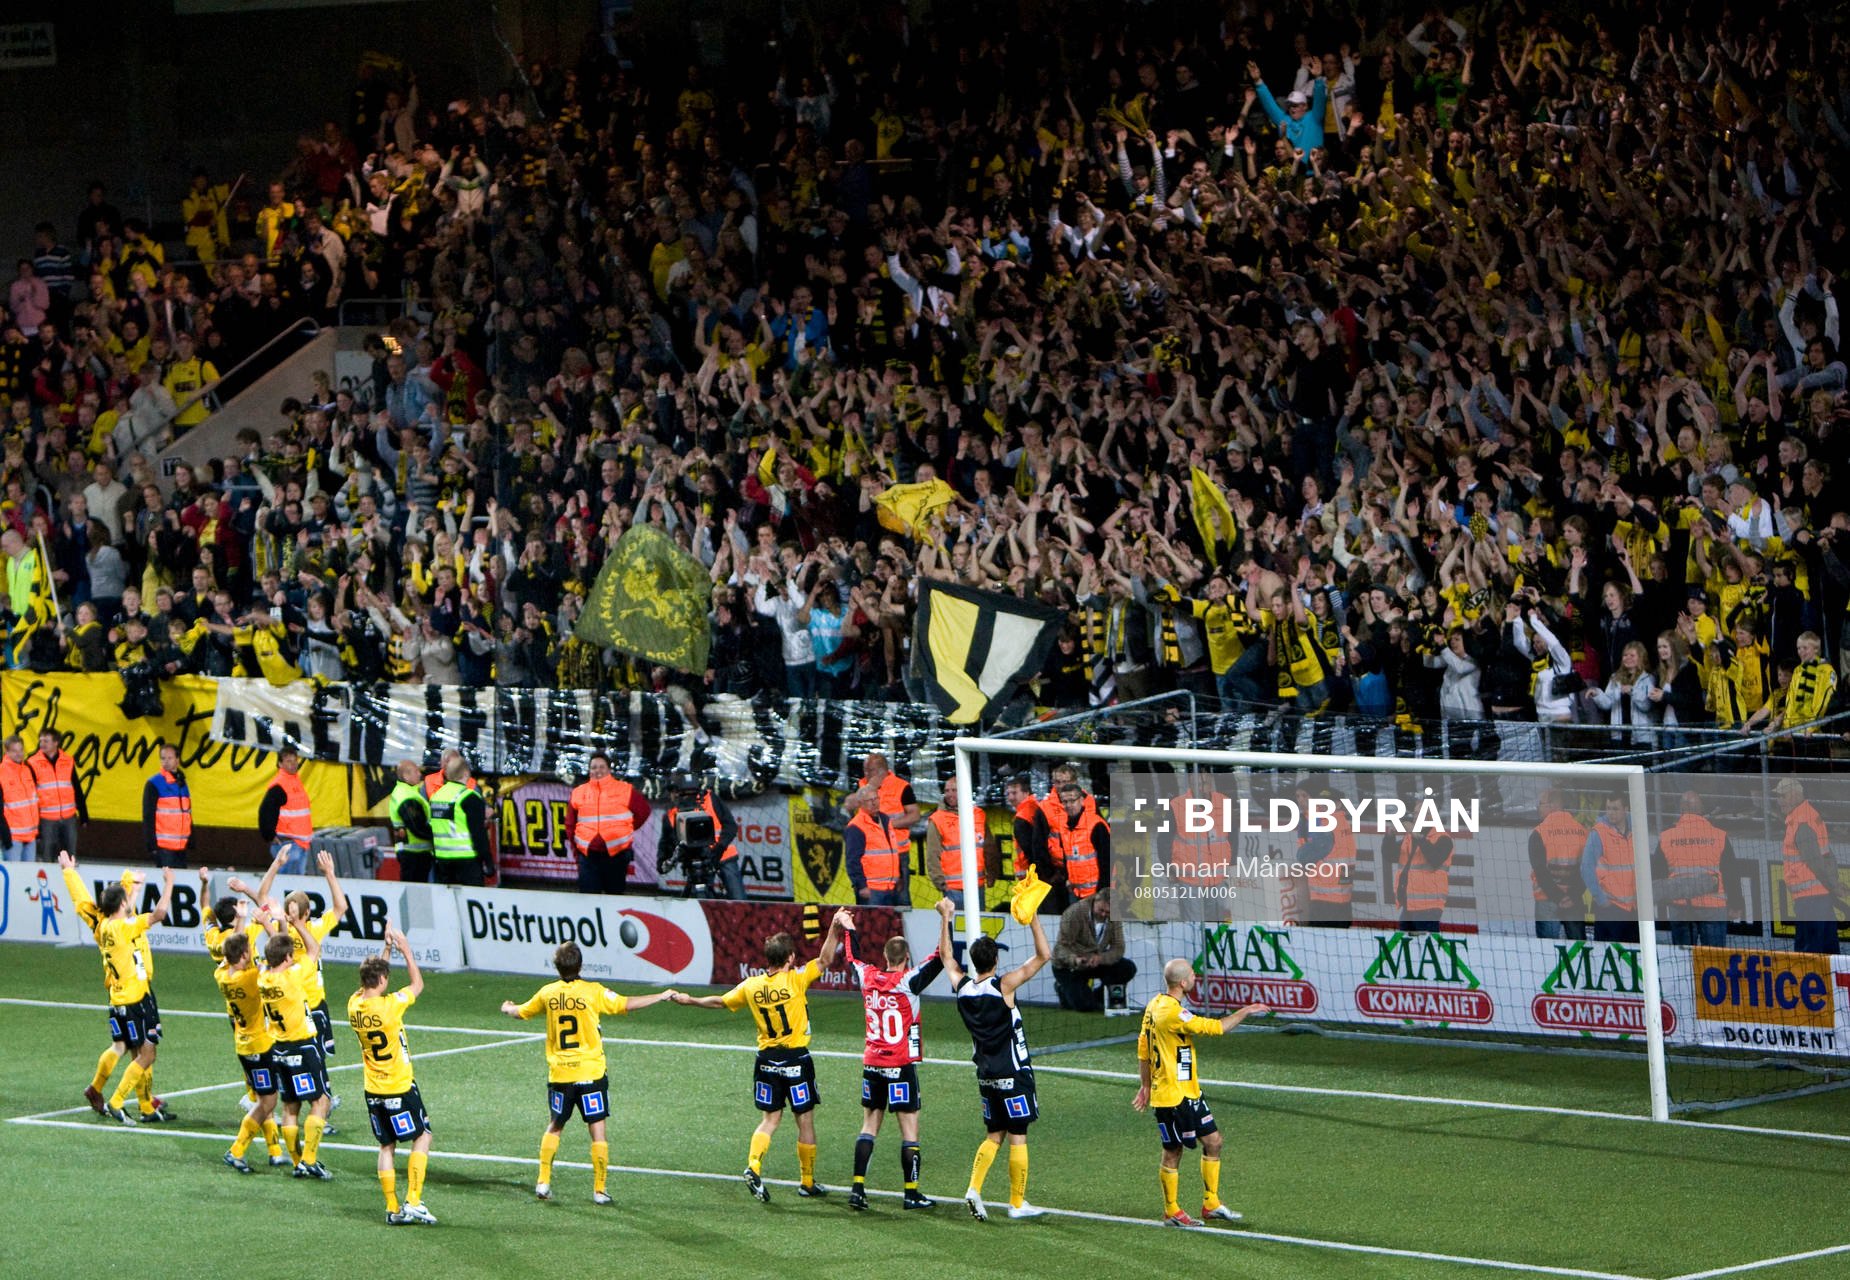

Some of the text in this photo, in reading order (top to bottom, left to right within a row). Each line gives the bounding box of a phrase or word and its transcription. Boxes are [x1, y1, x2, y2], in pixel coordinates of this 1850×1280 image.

[741, 855, 784, 882] AB
[467, 899, 608, 949] Distrupol
[425, 949, 441, 961] AB
[1205, 928, 1291, 973] MAT
[1374, 936, 1468, 983] MAT
[1554, 945, 1644, 993] MAT
[753, 985, 791, 1004] ellos
[1196, 981, 1304, 1006] KOMPANIET
[1702, 953, 1828, 1012] office
[549, 993, 586, 1010] ellos
[865, 990, 898, 1009] ellos
[1368, 990, 1479, 1016] KOMPANIET
[350, 1010, 382, 1028] ellos
[760, 1004, 793, 1038] 11
[866, 1009, 904, 1044] 30
[1545, 1001, 1647, 1027] KOMPANI
[558, 1015, 580, 1049] 2
[1723, 1027, 1835, 1050] DOCUMENT
